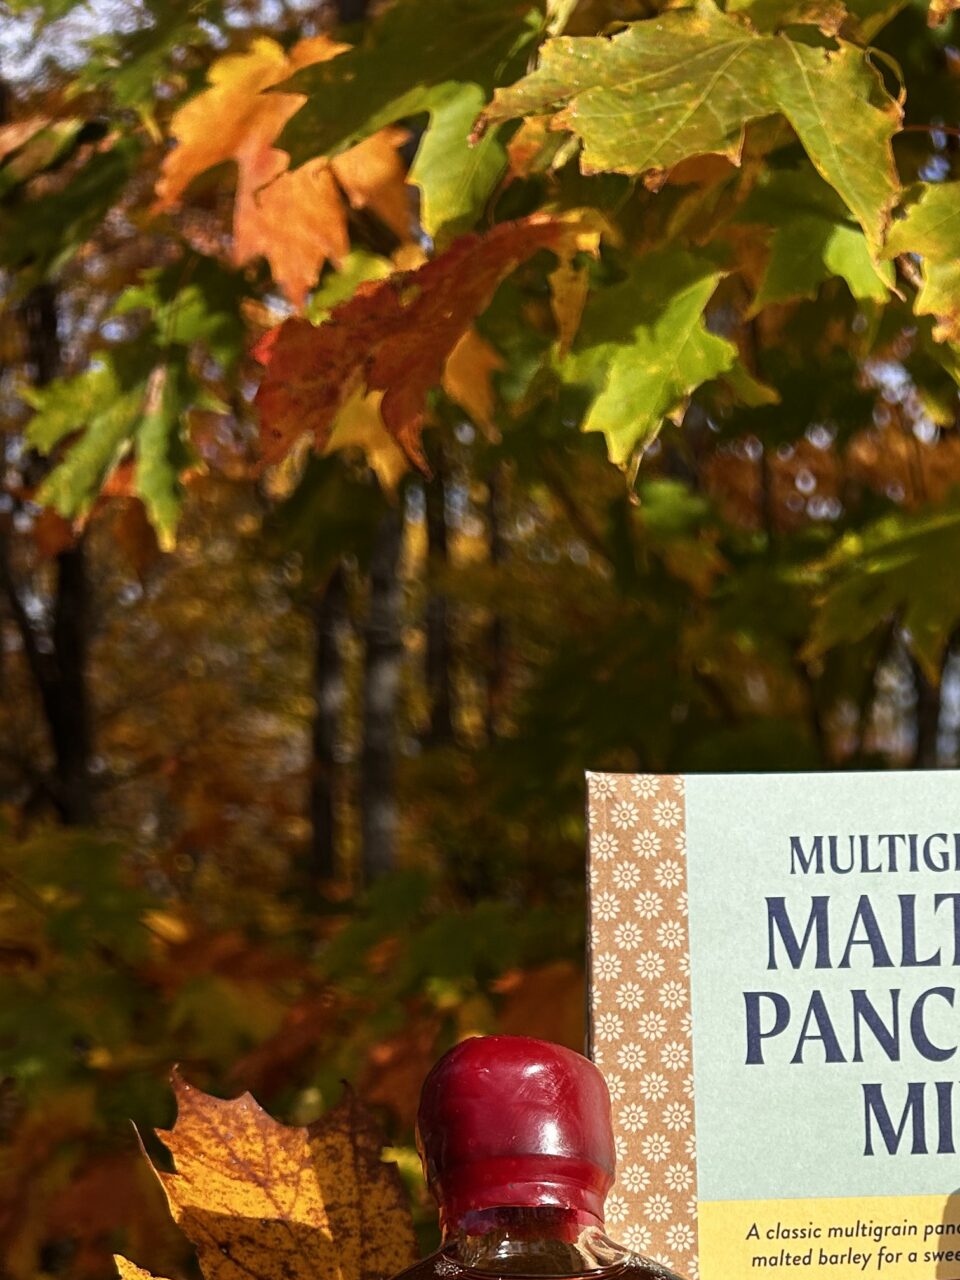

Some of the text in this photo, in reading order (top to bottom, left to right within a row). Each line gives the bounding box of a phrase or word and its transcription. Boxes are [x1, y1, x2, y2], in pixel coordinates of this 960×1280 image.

[746, 1223, 760, 1241] A
[766, 1221, 822, 1241] classic
[827, 1219, 918, 1242] multigrain
[752, 1247, 812, 1267] malted
[818, 1247, 871, 1271] barley
[876, 1246, 903, 1270] for
[908, 1251, 918, 1263] a
